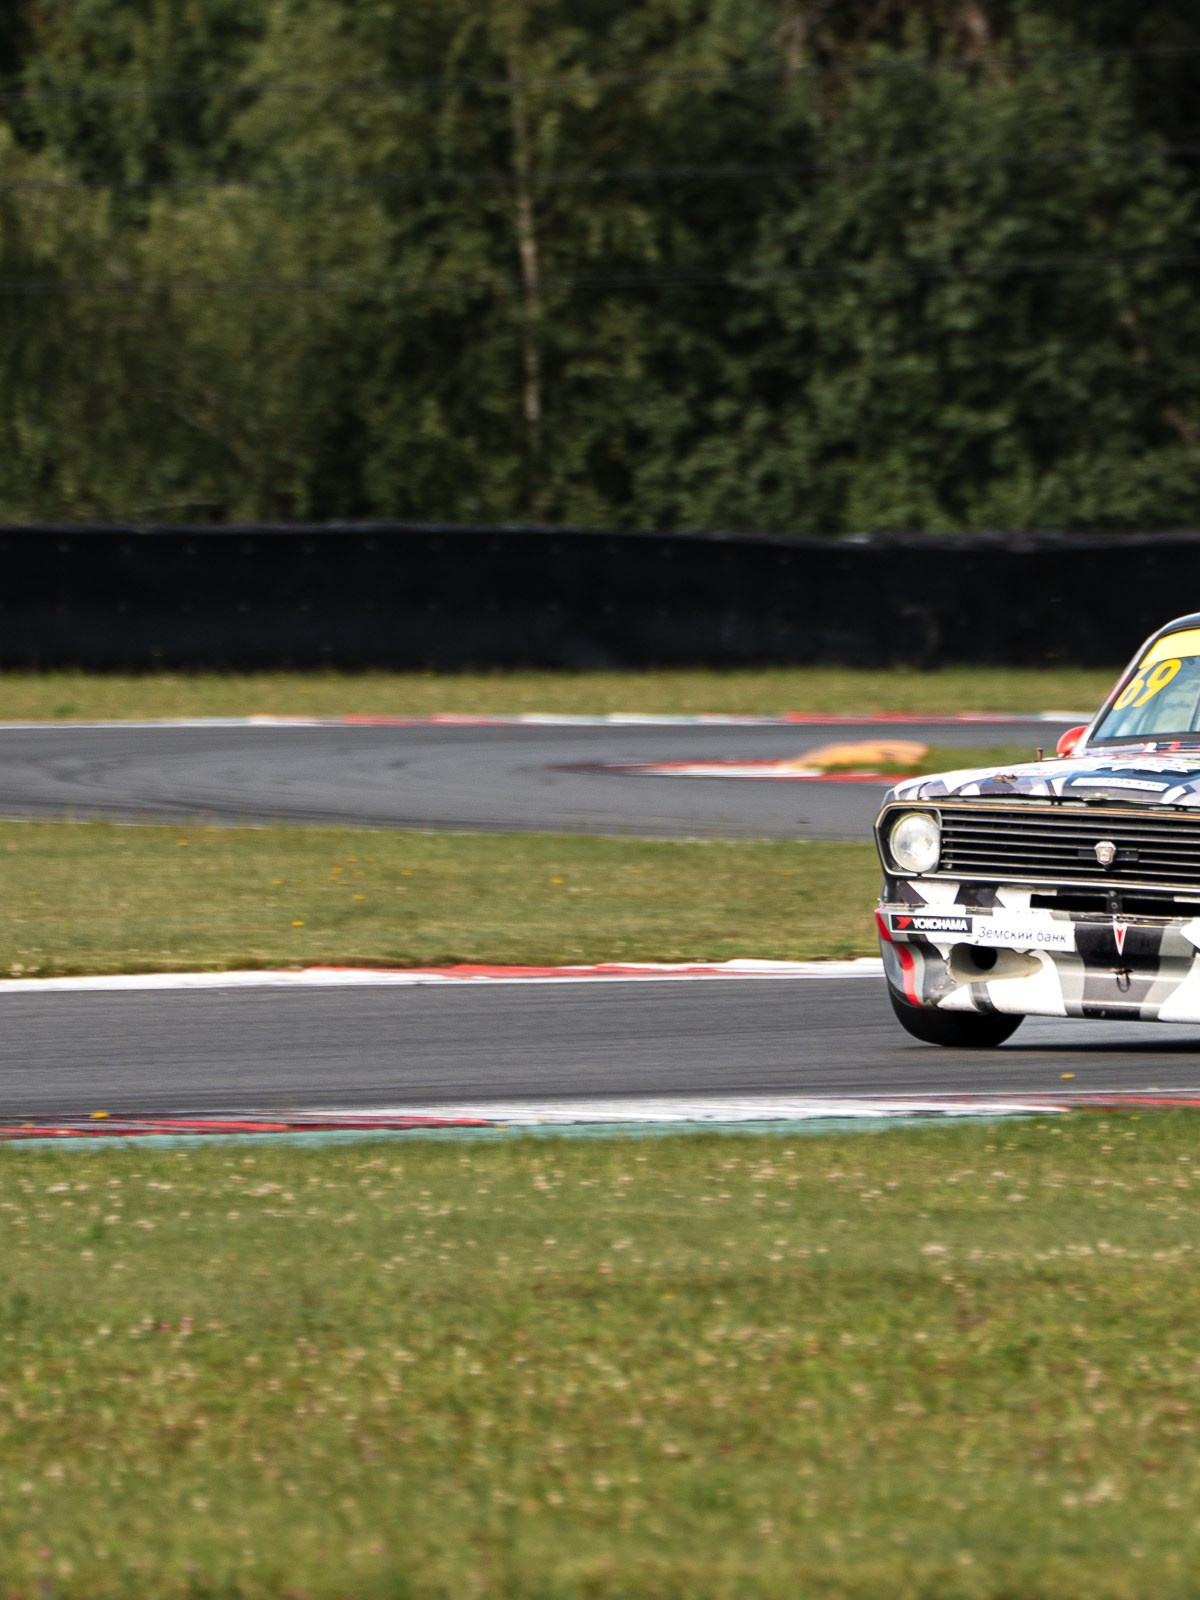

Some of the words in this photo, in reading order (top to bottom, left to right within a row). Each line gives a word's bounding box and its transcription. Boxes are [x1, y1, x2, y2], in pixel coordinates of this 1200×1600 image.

[1113, 658, 1182, 711] 69
[911, 917, 969, 932] YOKOHAMA
[977, 925, 1033, 940] Земский
[1036, 929, 1068, 944] банк
